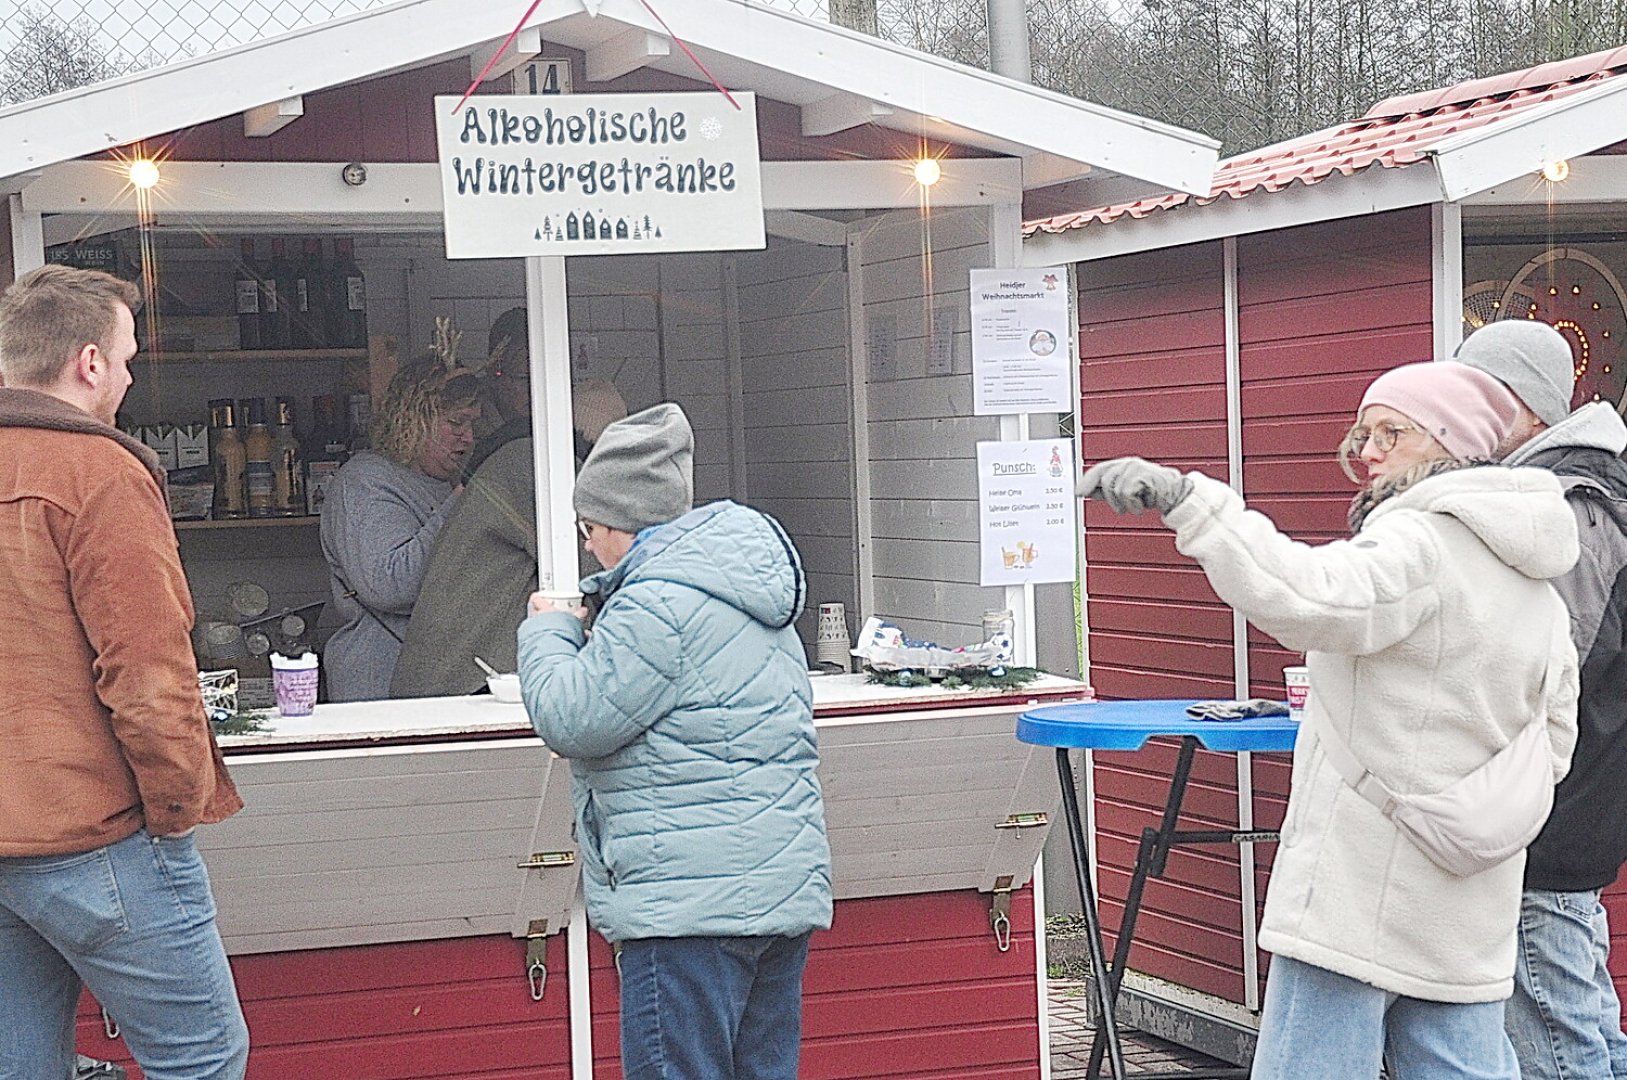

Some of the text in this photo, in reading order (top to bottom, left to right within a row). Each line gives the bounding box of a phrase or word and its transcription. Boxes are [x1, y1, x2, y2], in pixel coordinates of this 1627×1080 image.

[525, 64, 561, 95] 14
[460, 106, 687, 145] Alkoholische
[452, 156, 735, 195] Wintergetränke
[75, 249, 113, 260] WEISS
[1000, 281, 1026, 290] Heidjer
[981, 291, 1045, 301] Weihnachtsmarkt
[992, 462, 1036, 474] Punsch:
